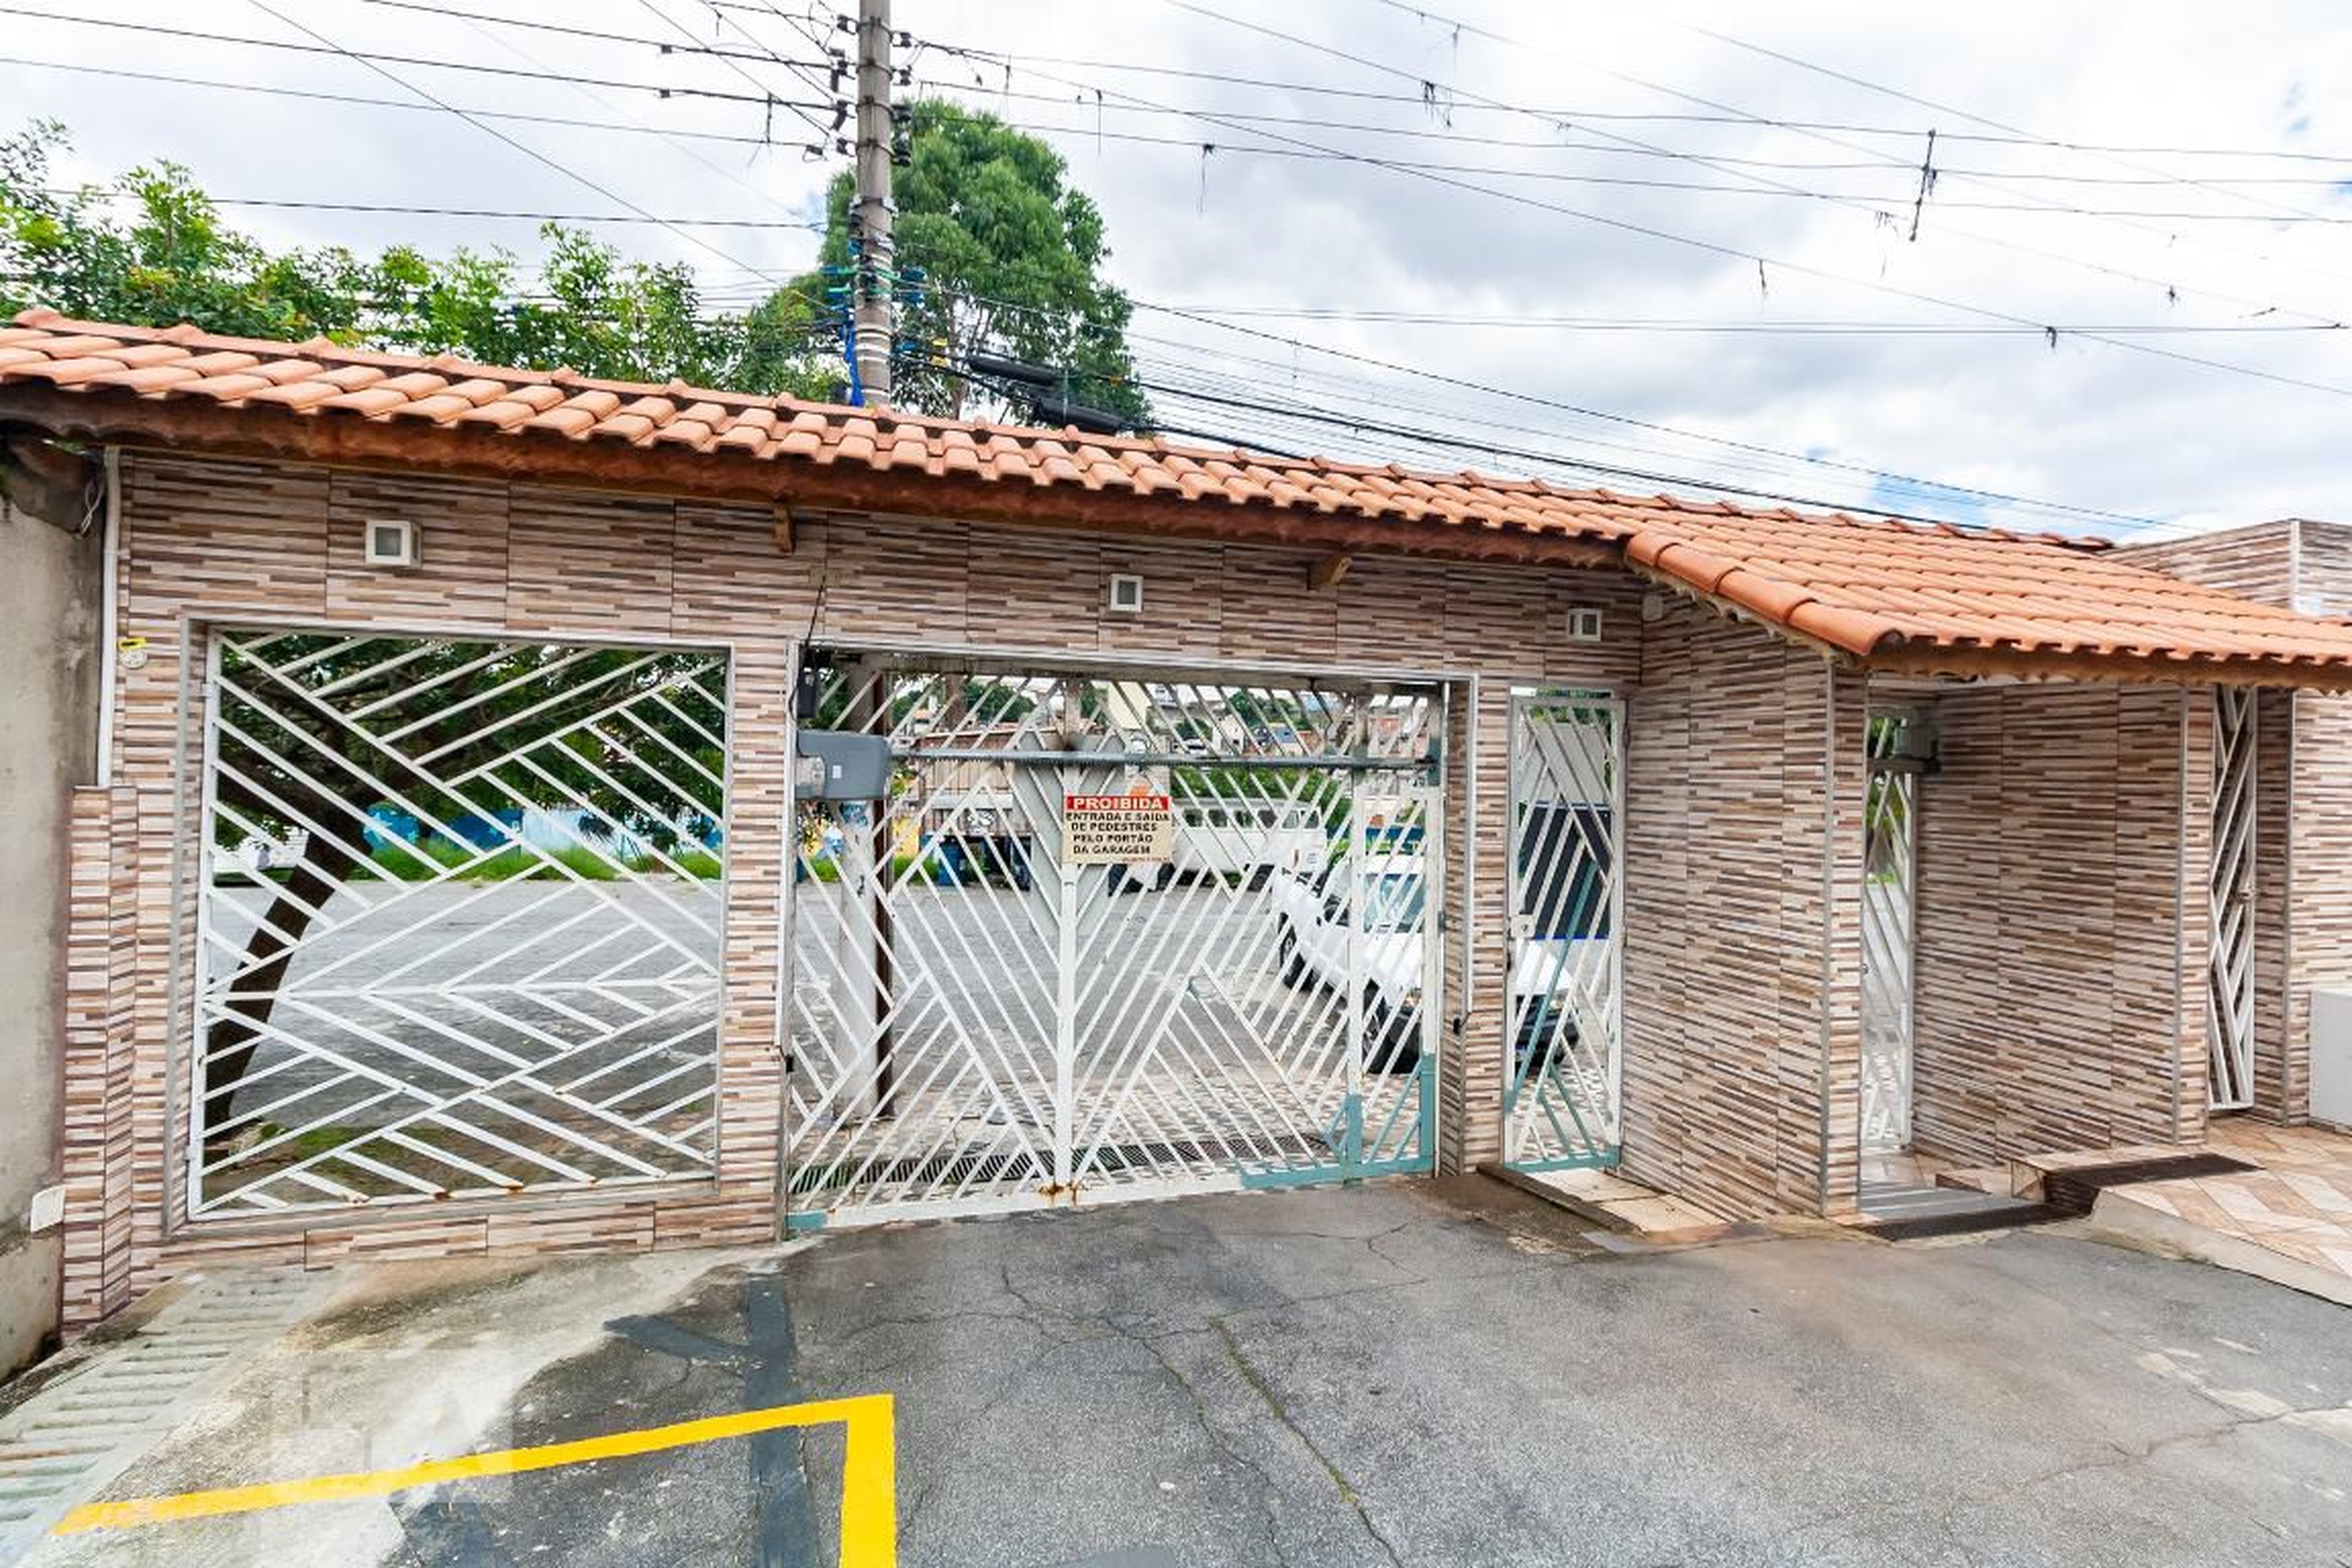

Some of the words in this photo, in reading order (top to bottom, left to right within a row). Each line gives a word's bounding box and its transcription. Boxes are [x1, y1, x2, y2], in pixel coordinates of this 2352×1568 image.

[1073, 797, 1163, 809] PROIBIDA
[1066, 812, 1121, 821] ENTRADA
[1071, 822, 1087, 831] DE
[1090, 822, 1158, 831] PEDESTRES
[1073, 834, 1104, 843] PELO
[1107, 833, 1153, 843] PORTÃO
[1073, 845, 1089, 854] DA
[1092, 845, 1151, 854] GARAGEM
